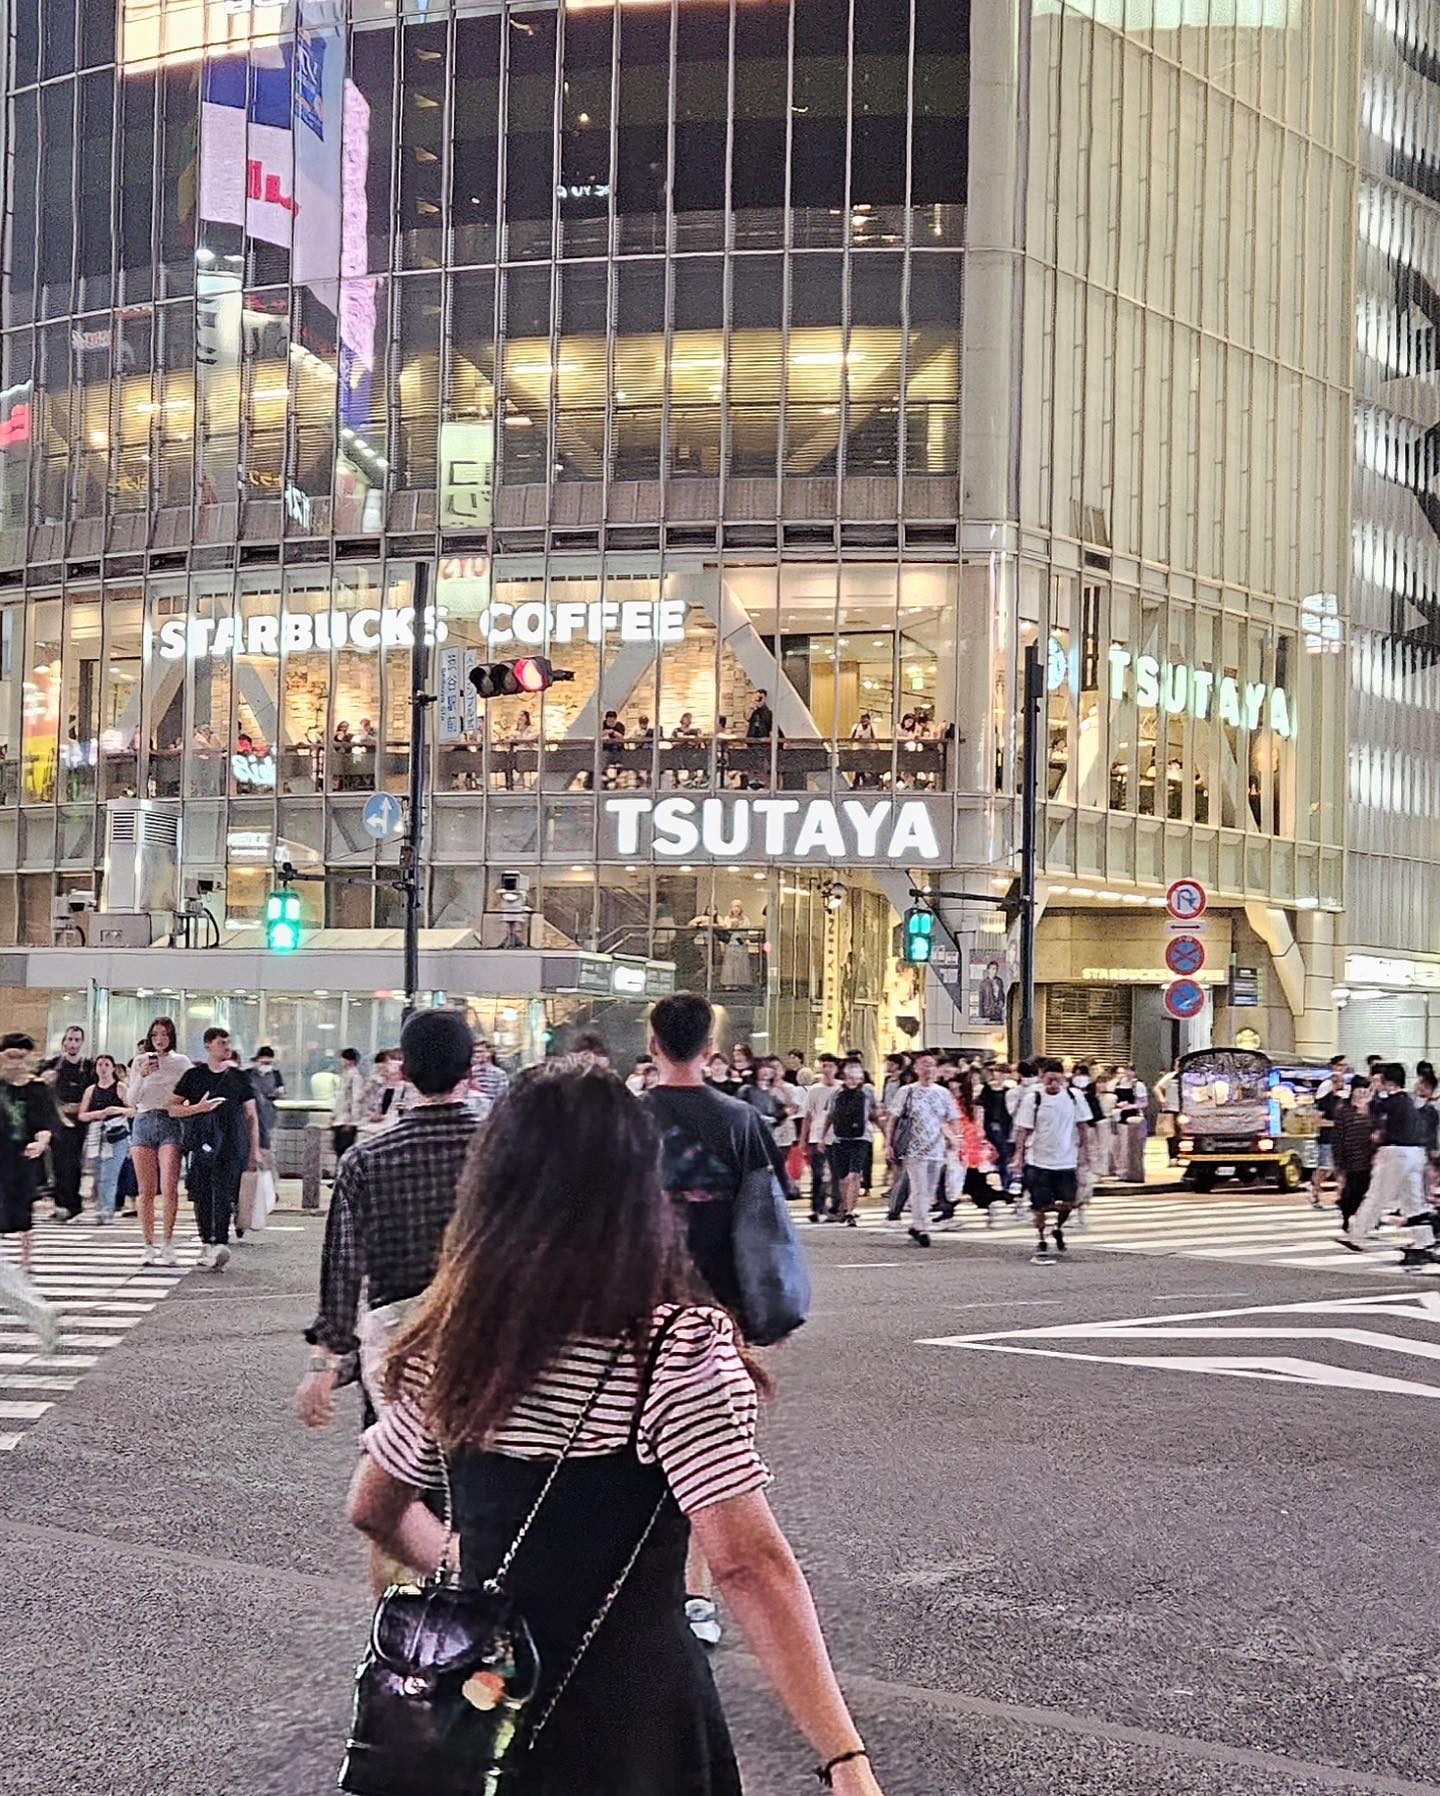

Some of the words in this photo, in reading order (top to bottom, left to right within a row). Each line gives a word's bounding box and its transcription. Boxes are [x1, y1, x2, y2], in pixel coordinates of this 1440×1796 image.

[159, 605, 449, 658] STARBUCKS
[479, 599, 686, 644] COFFEE
[1109, 650, 1292, 737] TSUTAYA
[605, 797, 940, 859] TSUTAYA
